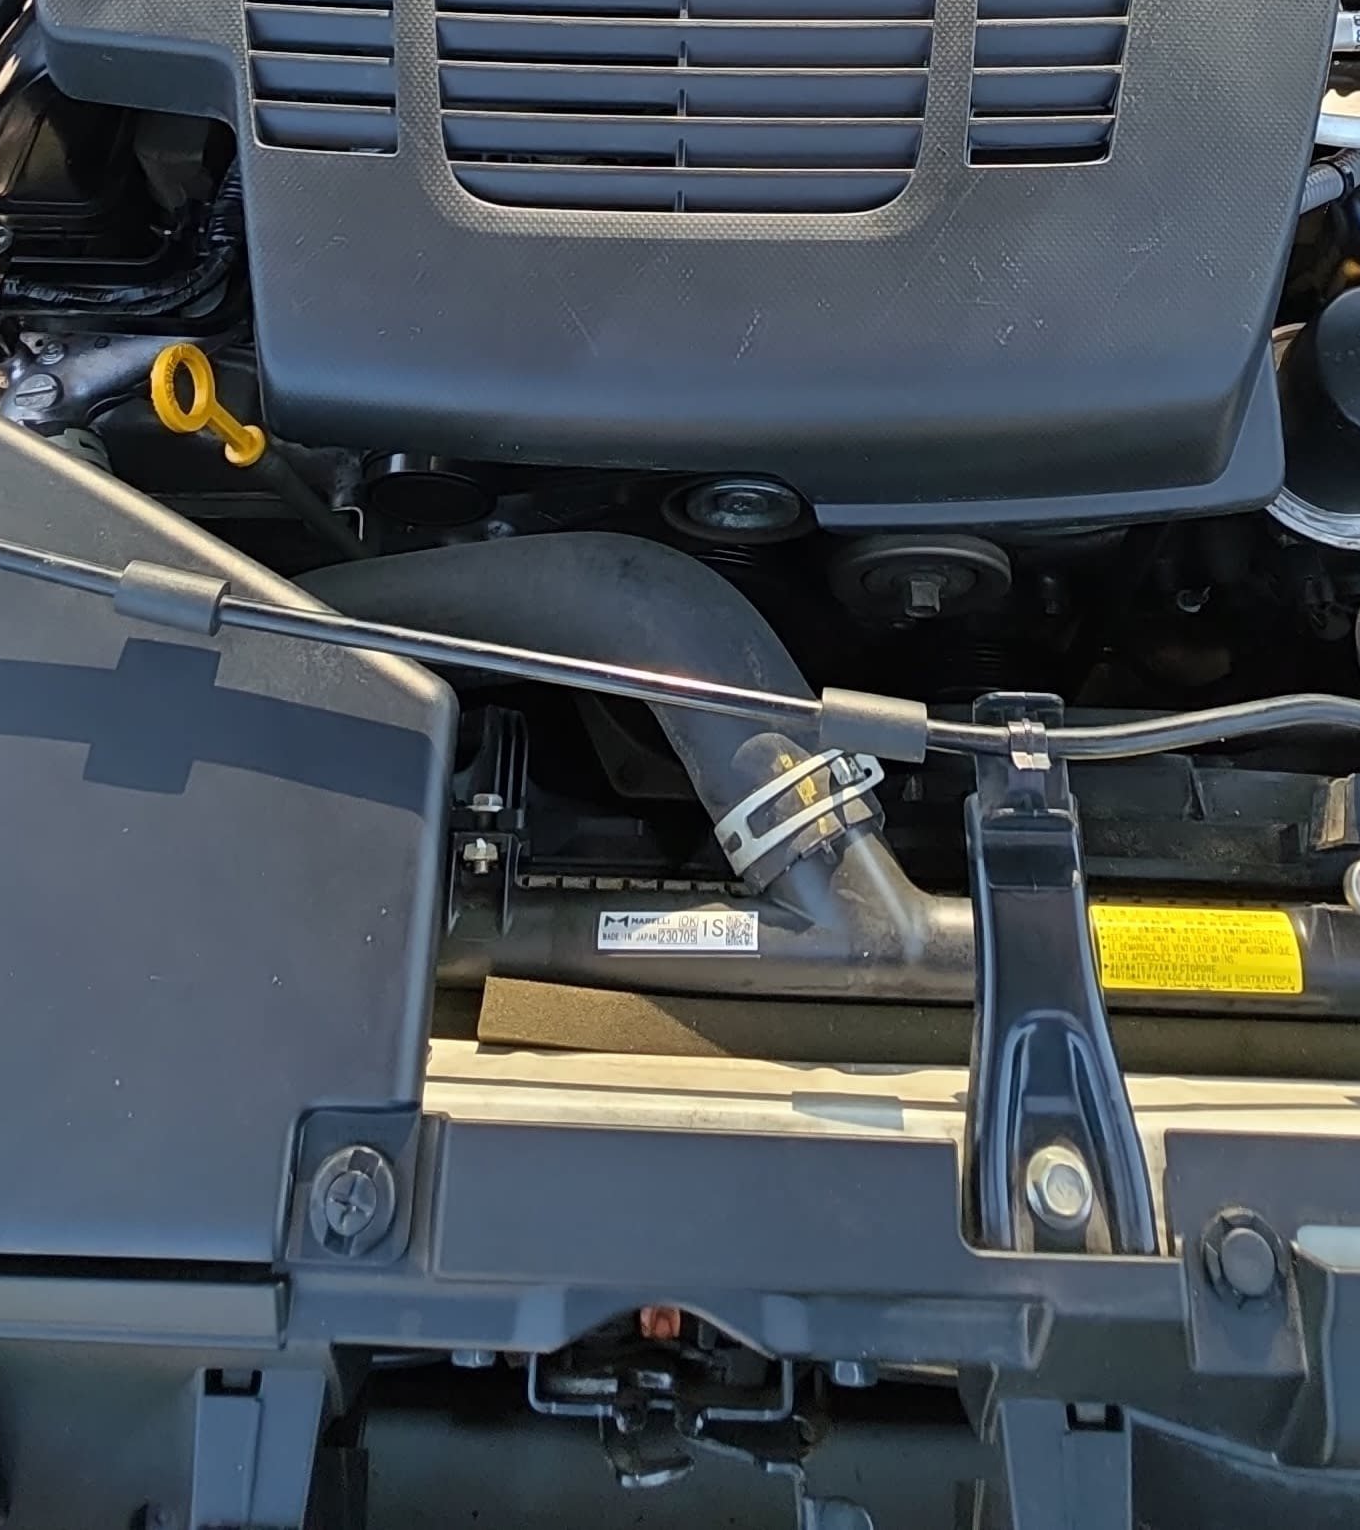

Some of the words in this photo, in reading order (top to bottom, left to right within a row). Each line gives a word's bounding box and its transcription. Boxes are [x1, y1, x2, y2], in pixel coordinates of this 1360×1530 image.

[631, 917, 671, 925] MARELLI
[602, 933, 619, 941] MADE
[636, 933, 657, 941] JAPAN
[659, 929, 696, 943] 230705
